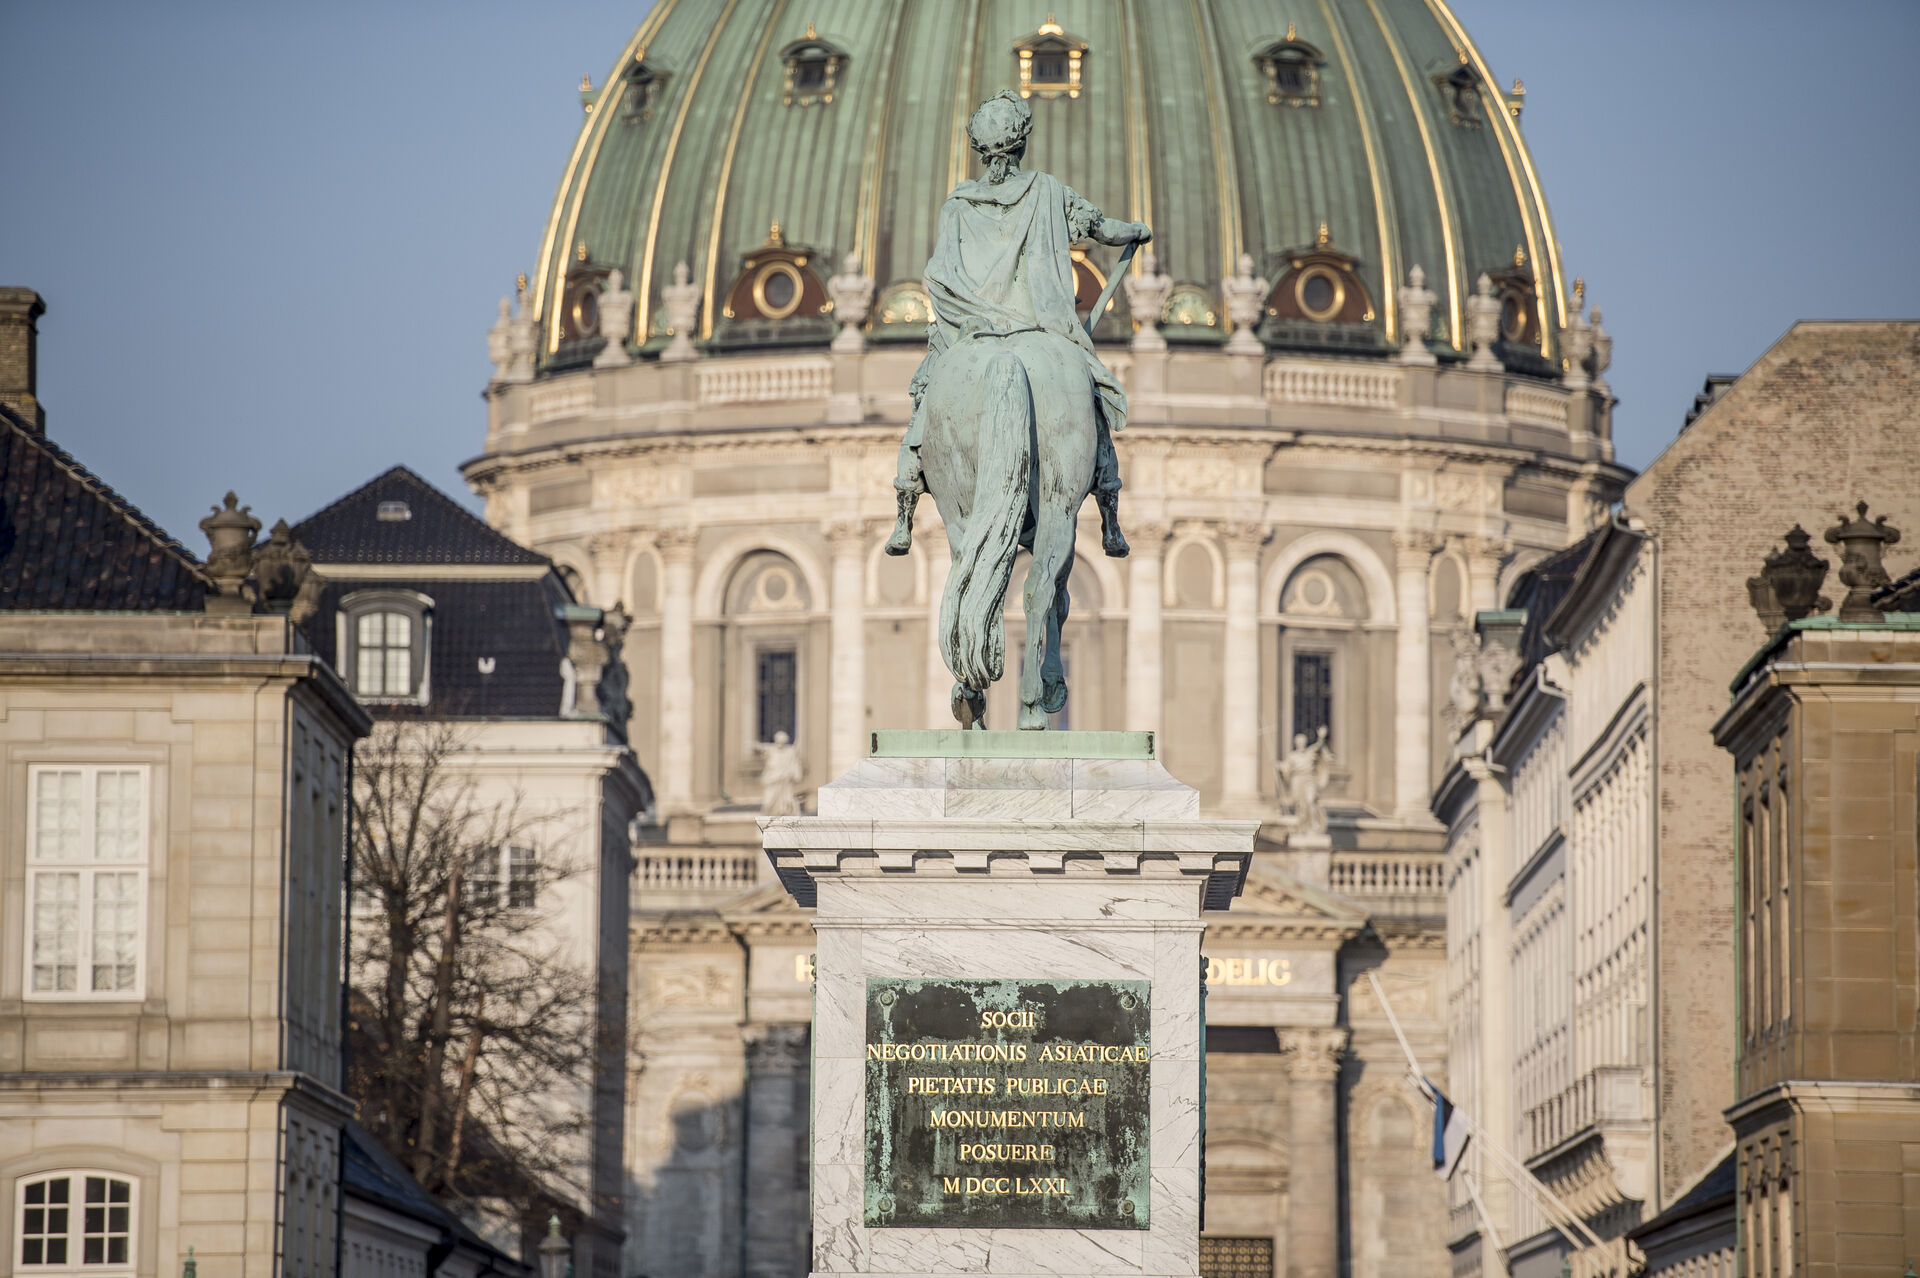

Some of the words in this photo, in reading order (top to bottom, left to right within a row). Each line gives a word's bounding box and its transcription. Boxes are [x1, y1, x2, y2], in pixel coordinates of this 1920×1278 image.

[981, 1011, 1035, 1029] SOCII
[867, 1043, 1027, 1062] NEGOTIATIONIS
[1039, 1045, 1149, 1063] ASIATICAE
[908, 1077, 996, 1095] PIETATIS
[1006, 1078, 1108, 1096] PUBLICAE
[929, 1110, 1085, 1129] MONUMENTUM
[960, 1144, 1055, 1161] POSUERE
